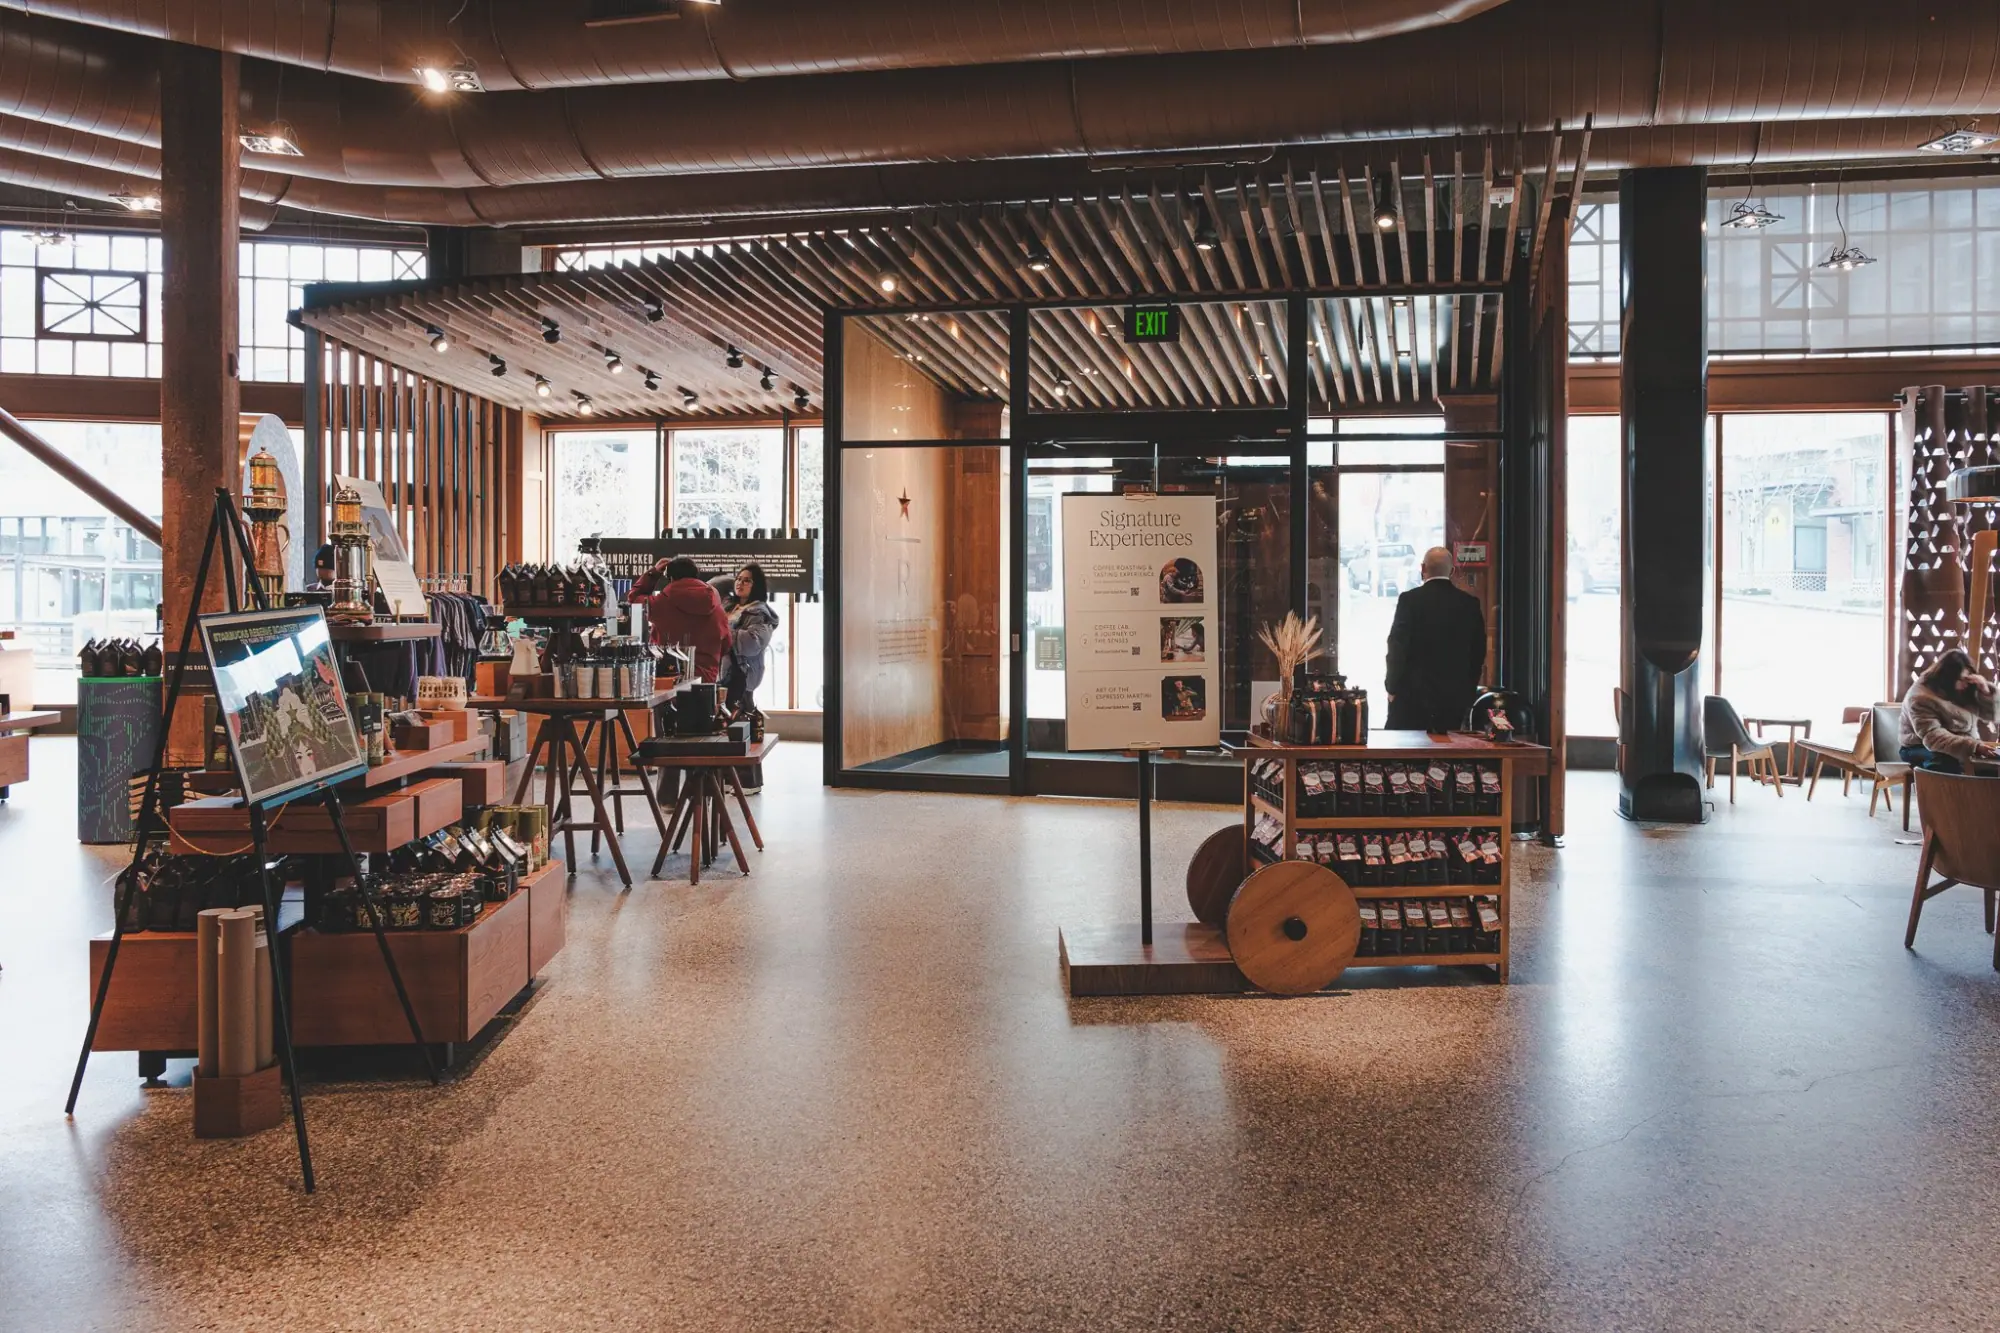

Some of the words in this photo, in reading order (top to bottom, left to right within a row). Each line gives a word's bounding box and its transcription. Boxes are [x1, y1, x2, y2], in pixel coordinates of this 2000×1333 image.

[1135, 311, 1169, 336] EXIT
[1100, 510, 1181, 530] Signature
[1089, 529, 1193, 550] Experiences
[601, 553, 654, 564] HANDPICKED
[614, 565, 629, 576] THE
[497, 882, 507, 894] R
